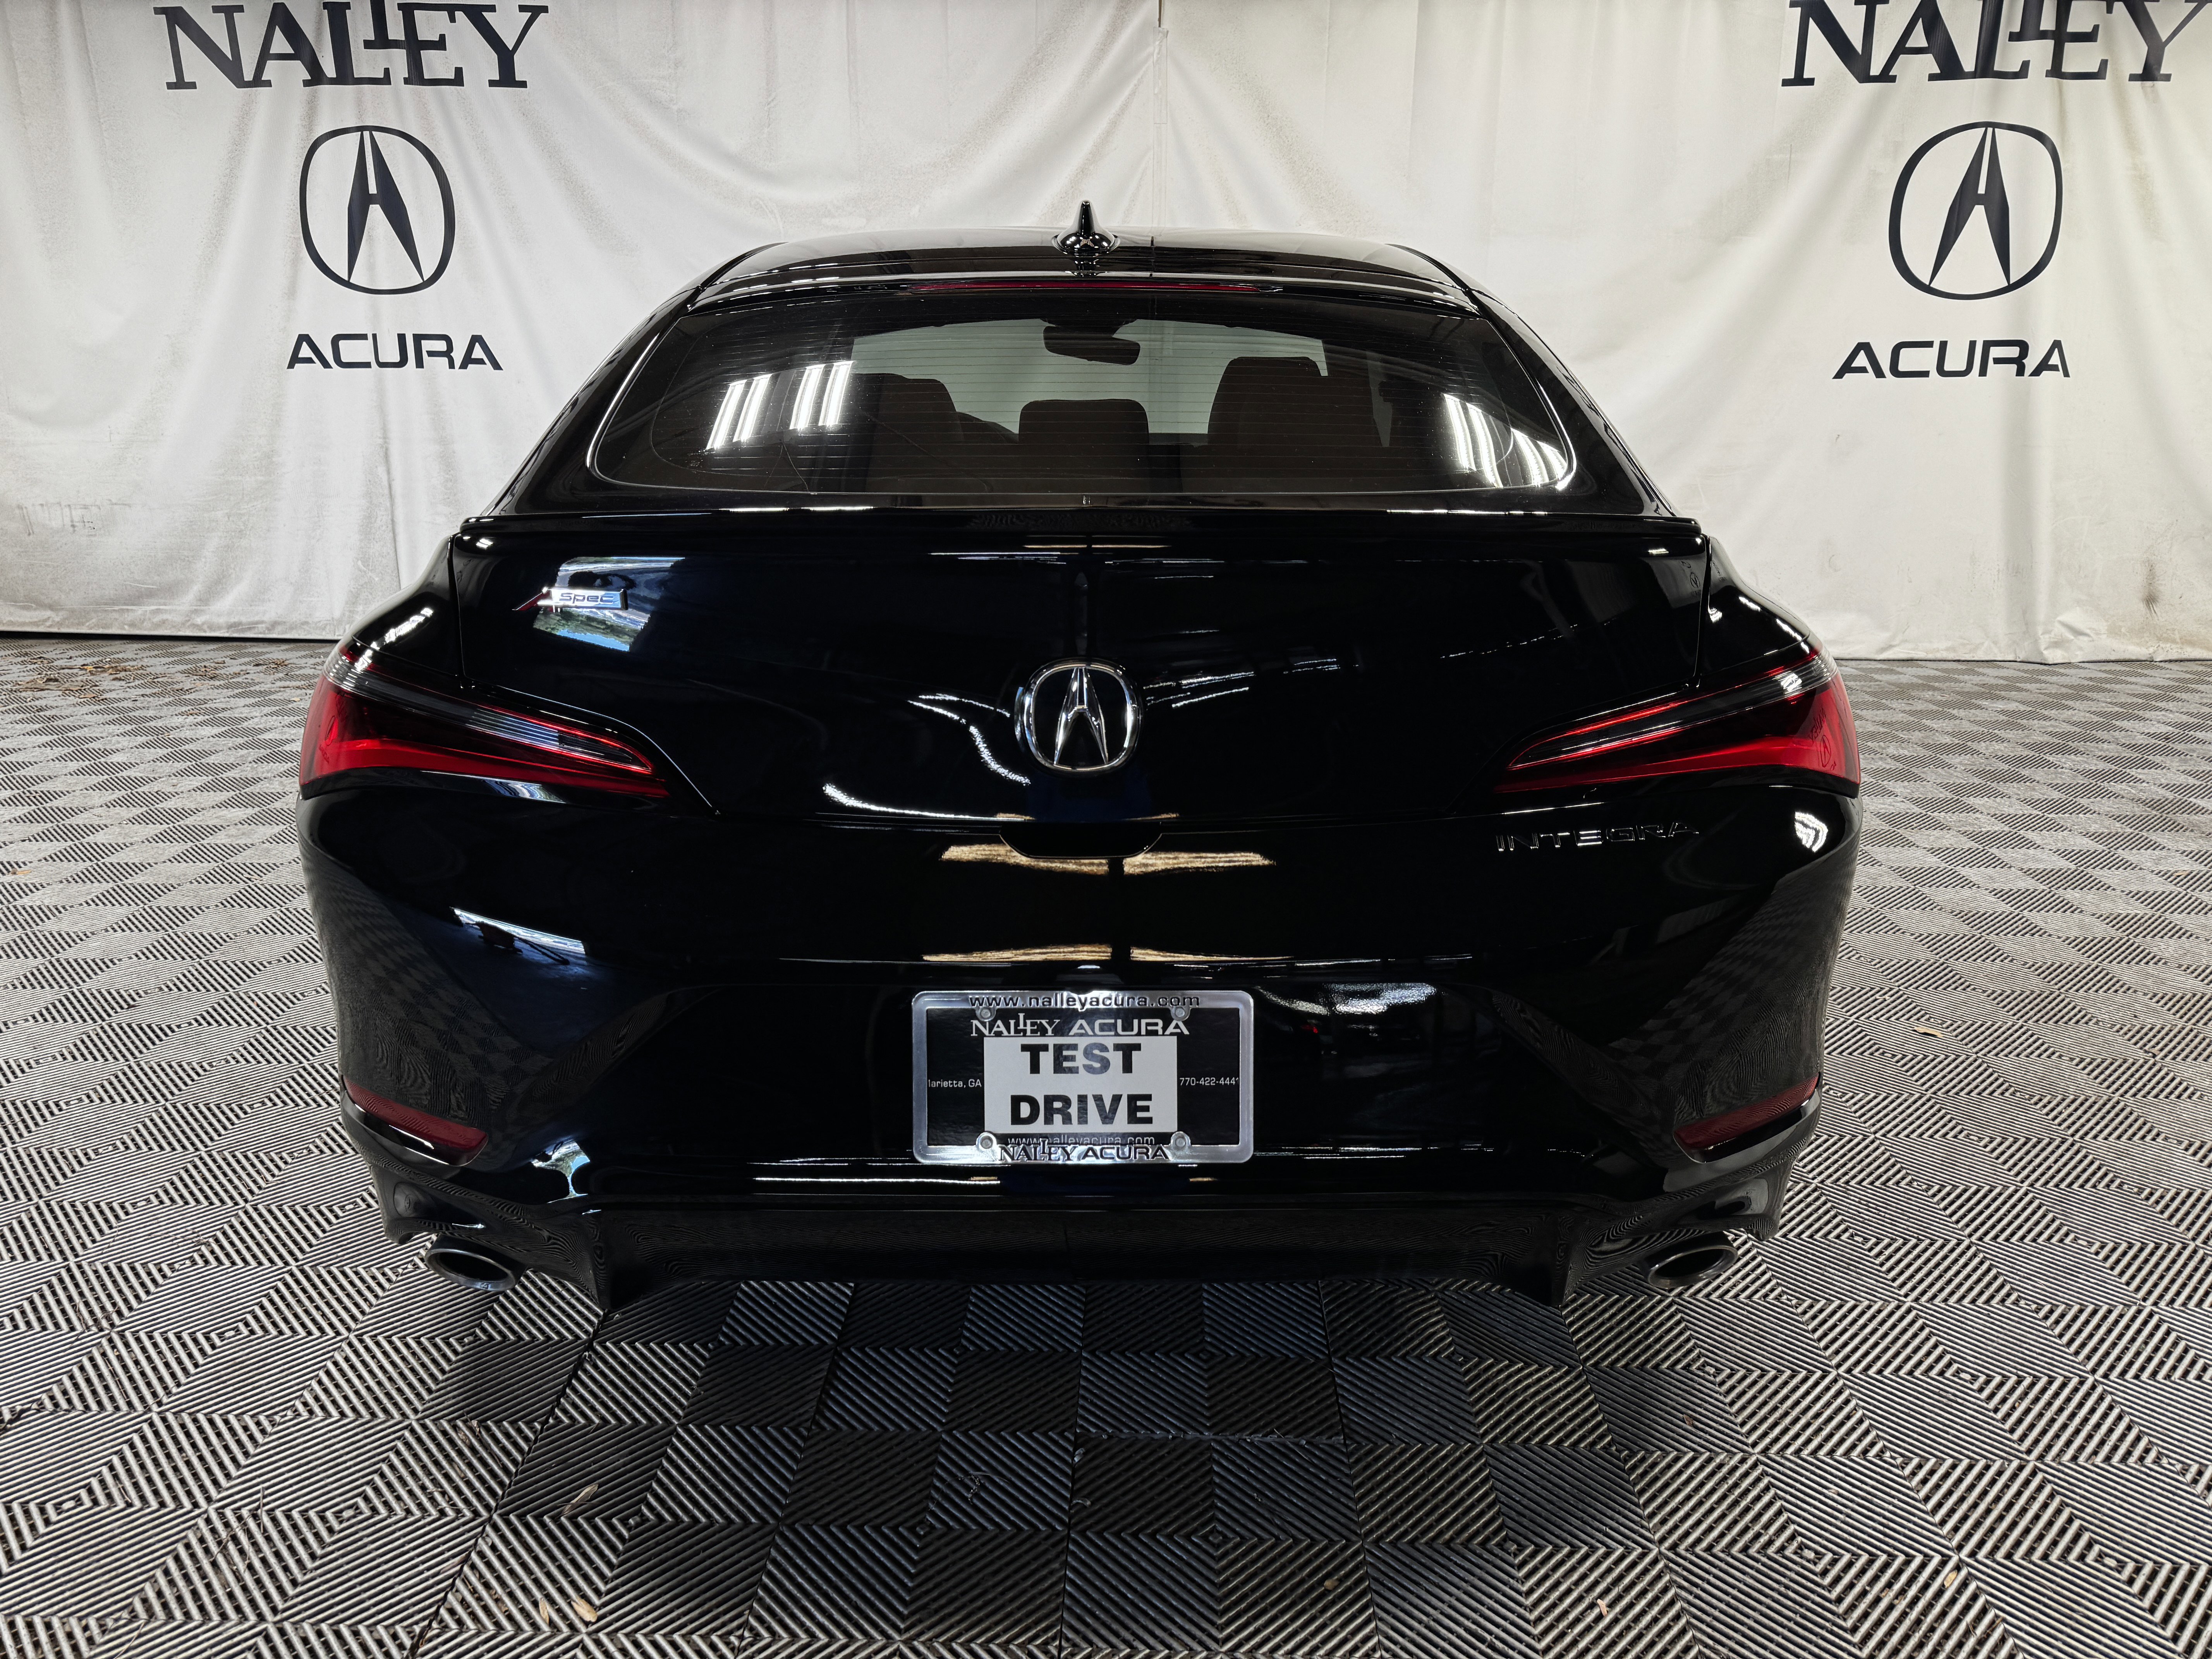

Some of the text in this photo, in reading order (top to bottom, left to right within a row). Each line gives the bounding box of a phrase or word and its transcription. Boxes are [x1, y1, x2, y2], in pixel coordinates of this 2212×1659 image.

[153, 0, 548, 89] NALLEY
[287, 333, 503, 371] ACURA
[1832, 339, 2070, 379] ACURA
[1496, 822, 1699, 851] INTEGRA
[969, 992, 1200, 1010] www.nalleyacura.com
[970, 1013, 1190, 1036] NALLEY ACURA
[1020, 1042, 1142, 1075] TEST
[928, 1079, 982, 1088] arietta, GA
[1010, 1093, 1153, 1125] DRIVE
[998, 1137, 1170, 1161] NALLEY ACURA
